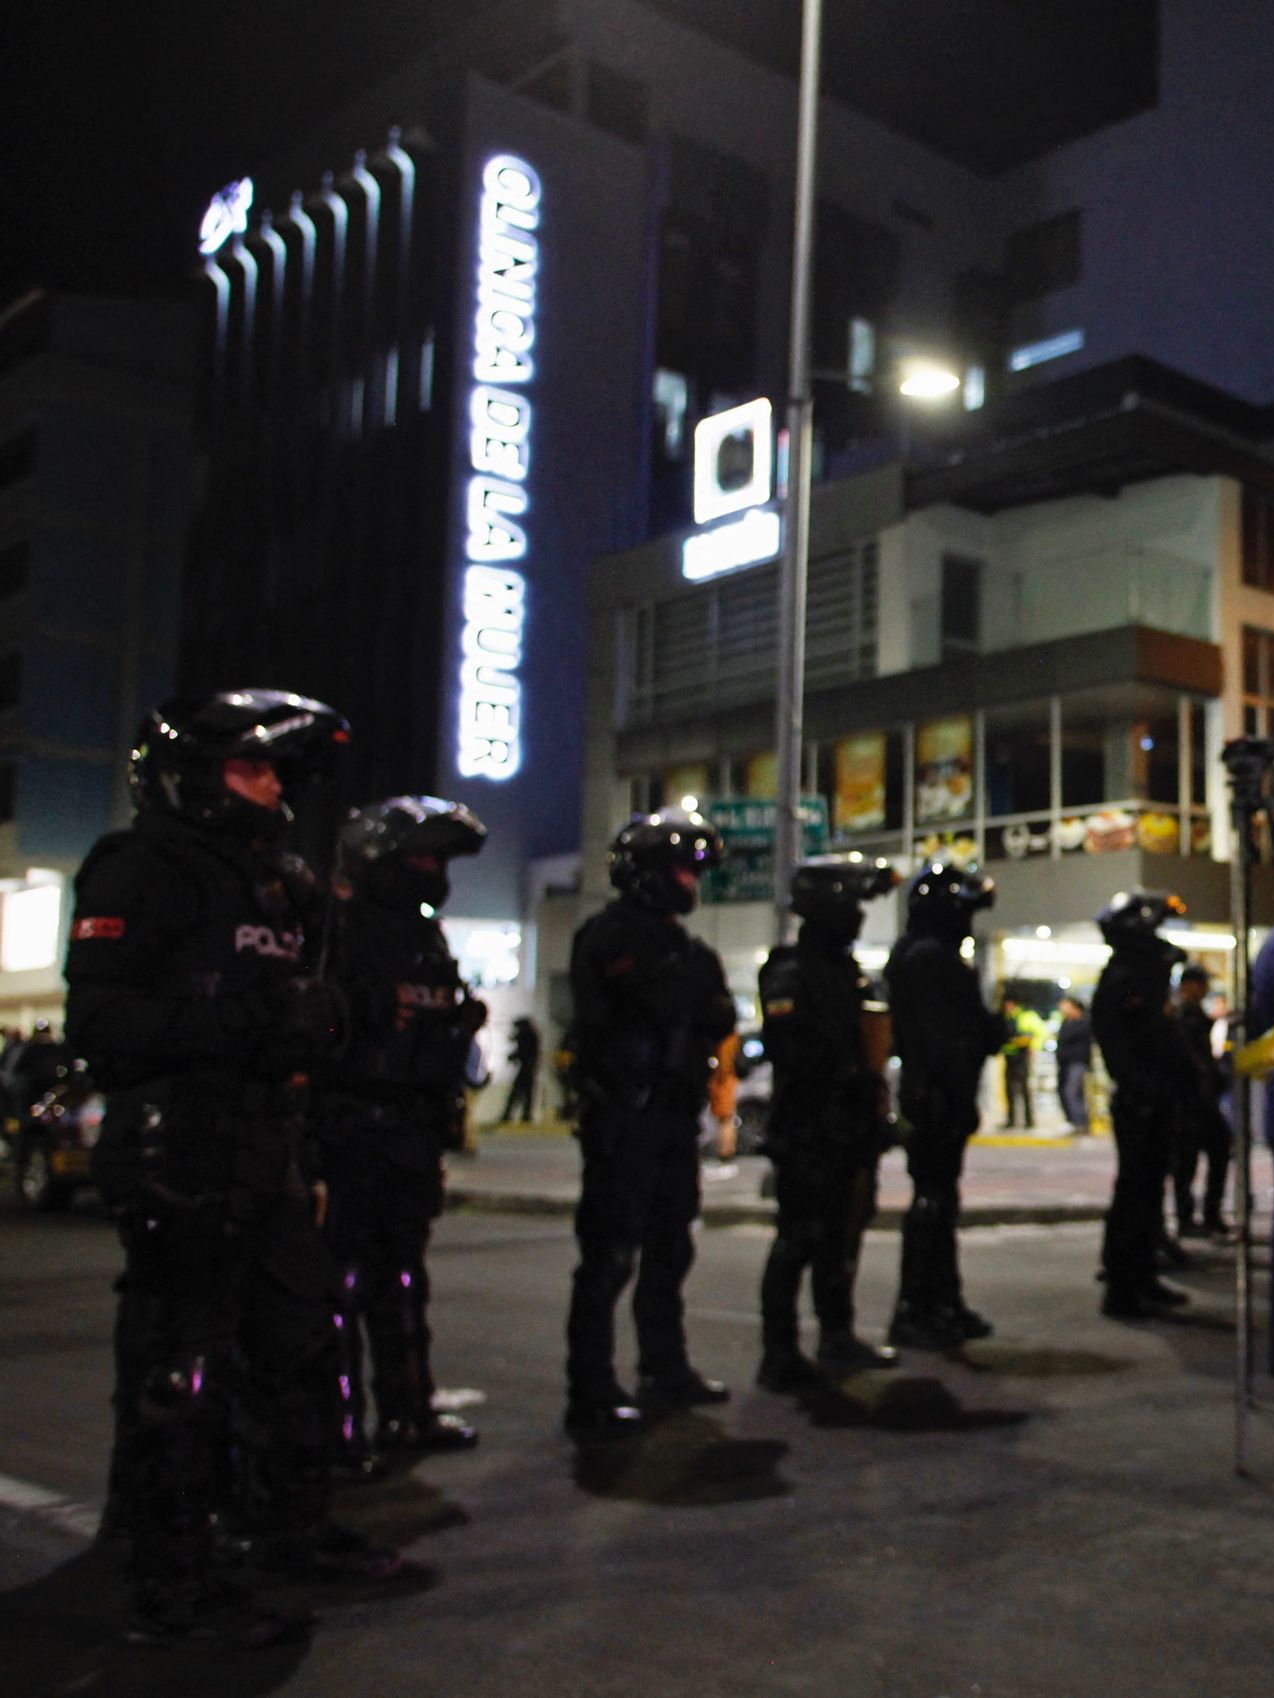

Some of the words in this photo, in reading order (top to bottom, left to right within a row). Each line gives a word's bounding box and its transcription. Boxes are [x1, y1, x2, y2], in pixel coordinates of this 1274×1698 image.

[474, 155, 541, 382] CLINICA
[470, 385, 531, 480] DE
[466, 475, 528, 562] LA
[458, 564, 524, 782] MUJER
